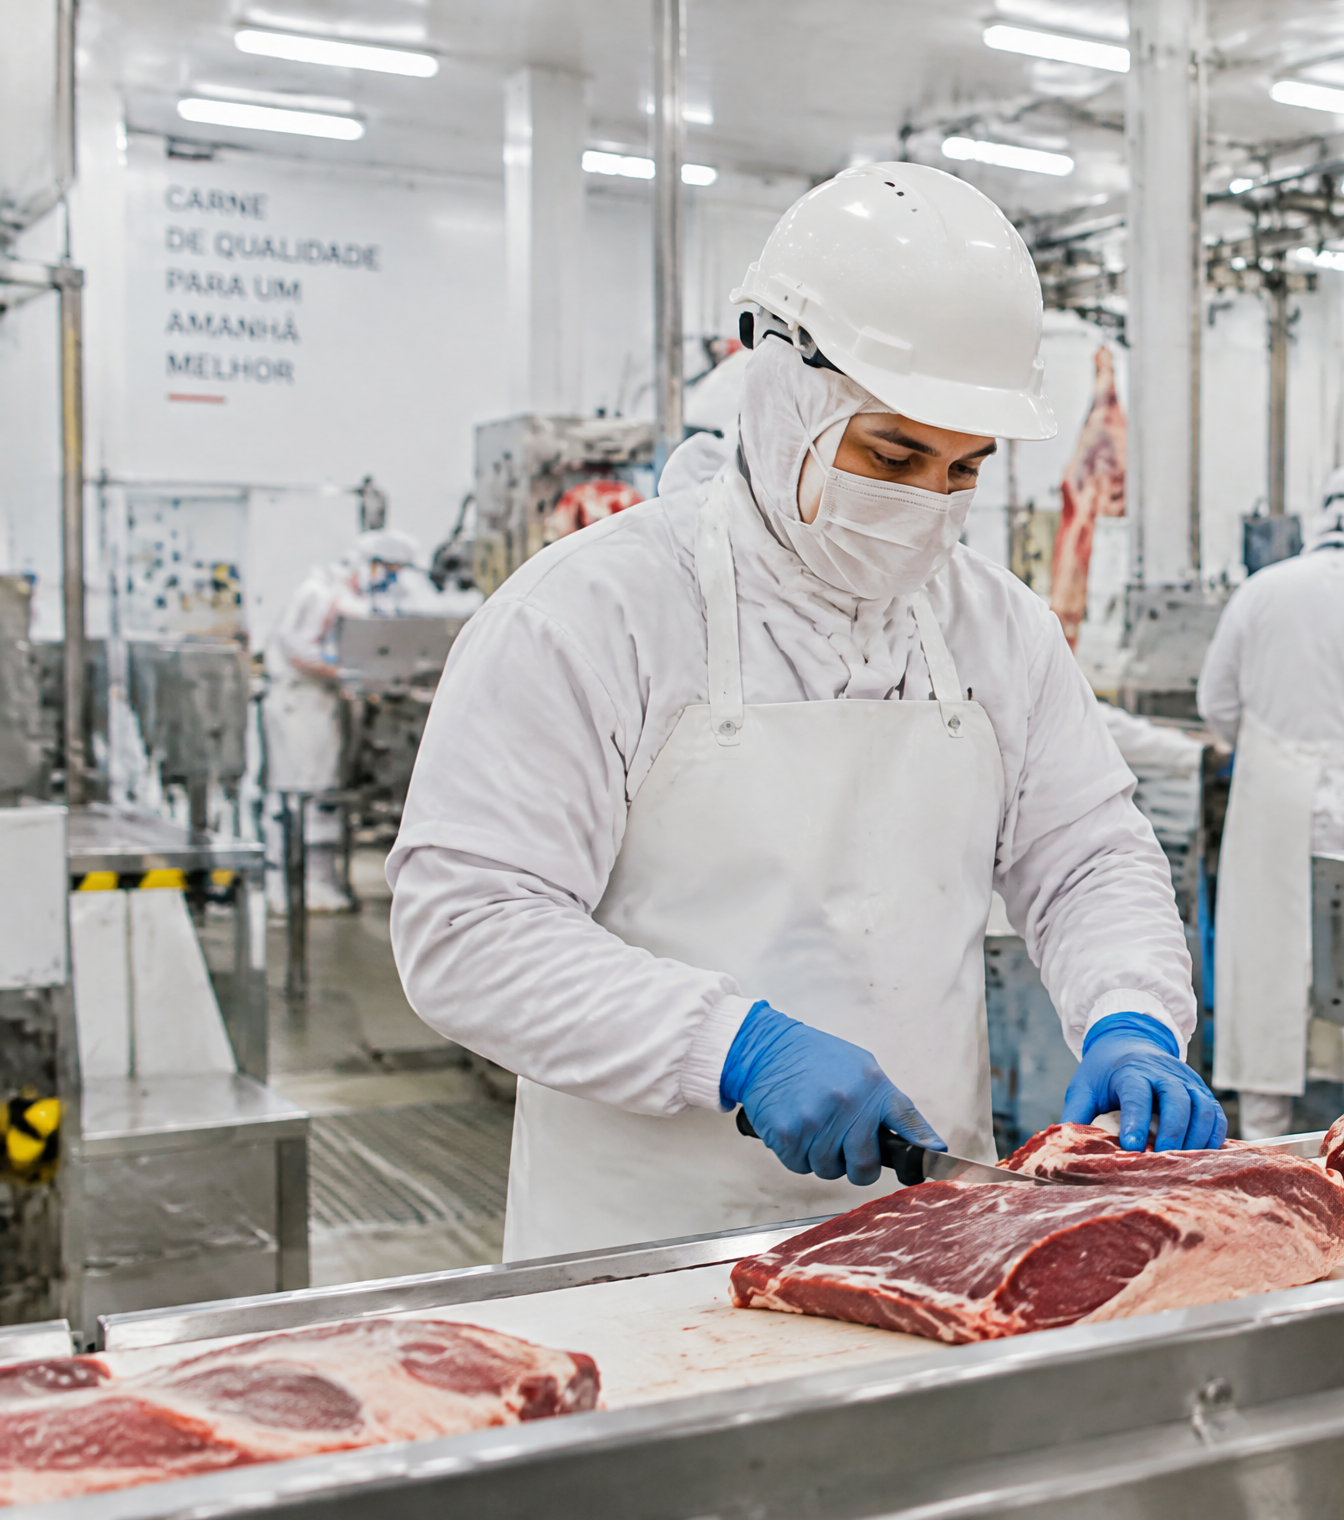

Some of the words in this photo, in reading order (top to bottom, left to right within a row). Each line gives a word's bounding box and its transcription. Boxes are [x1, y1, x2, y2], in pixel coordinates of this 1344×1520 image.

[165, 185, 268, 221] CARNE
[165, 225, 206, 257] DE
[214, 231, 383, 272] QUALIDADE
[166, 267, 247, 301] PARA
[253, 274, 303, 304] UM
[166, 351, 296, 386] MELHOR
